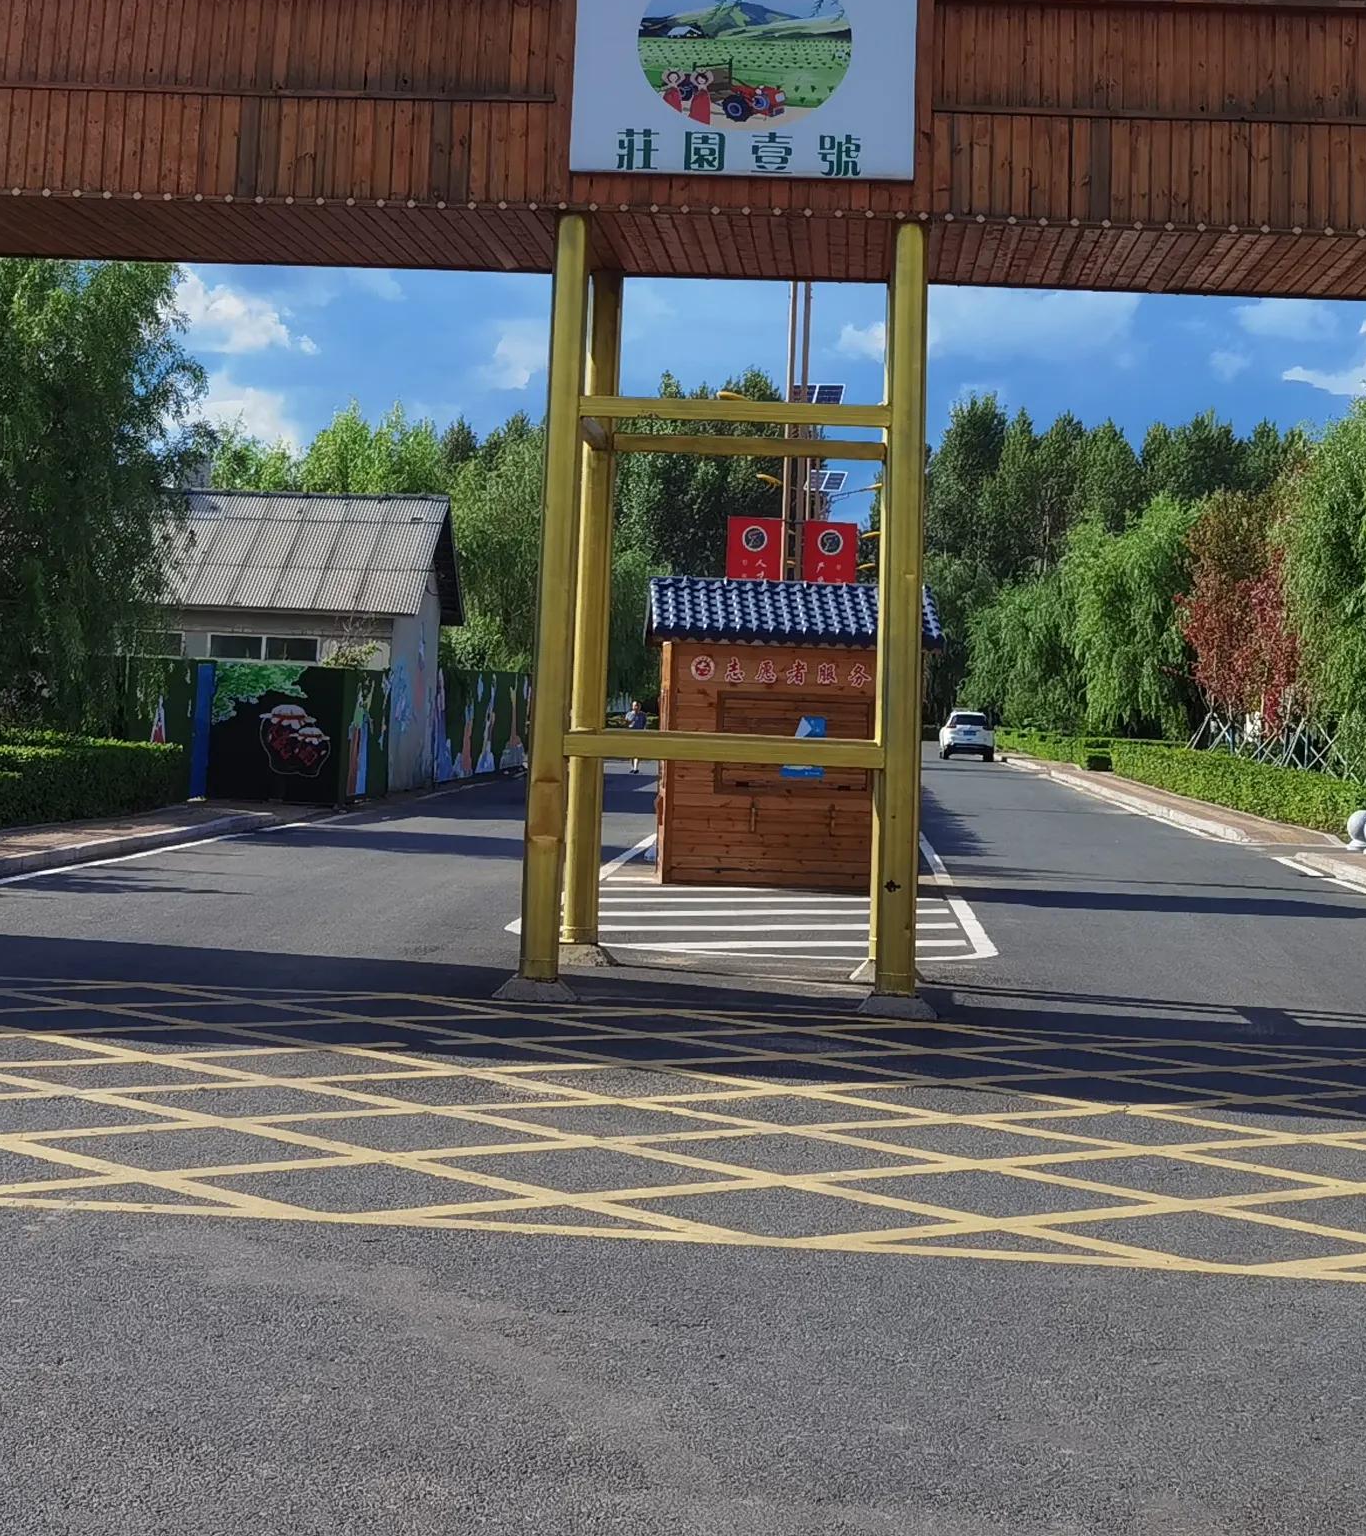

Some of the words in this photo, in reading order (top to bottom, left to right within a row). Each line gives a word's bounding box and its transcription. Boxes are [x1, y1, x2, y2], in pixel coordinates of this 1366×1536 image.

[616, 127, 861, 177] 莊園壹號
[724, 656, 872, 688] 志愿者服务
